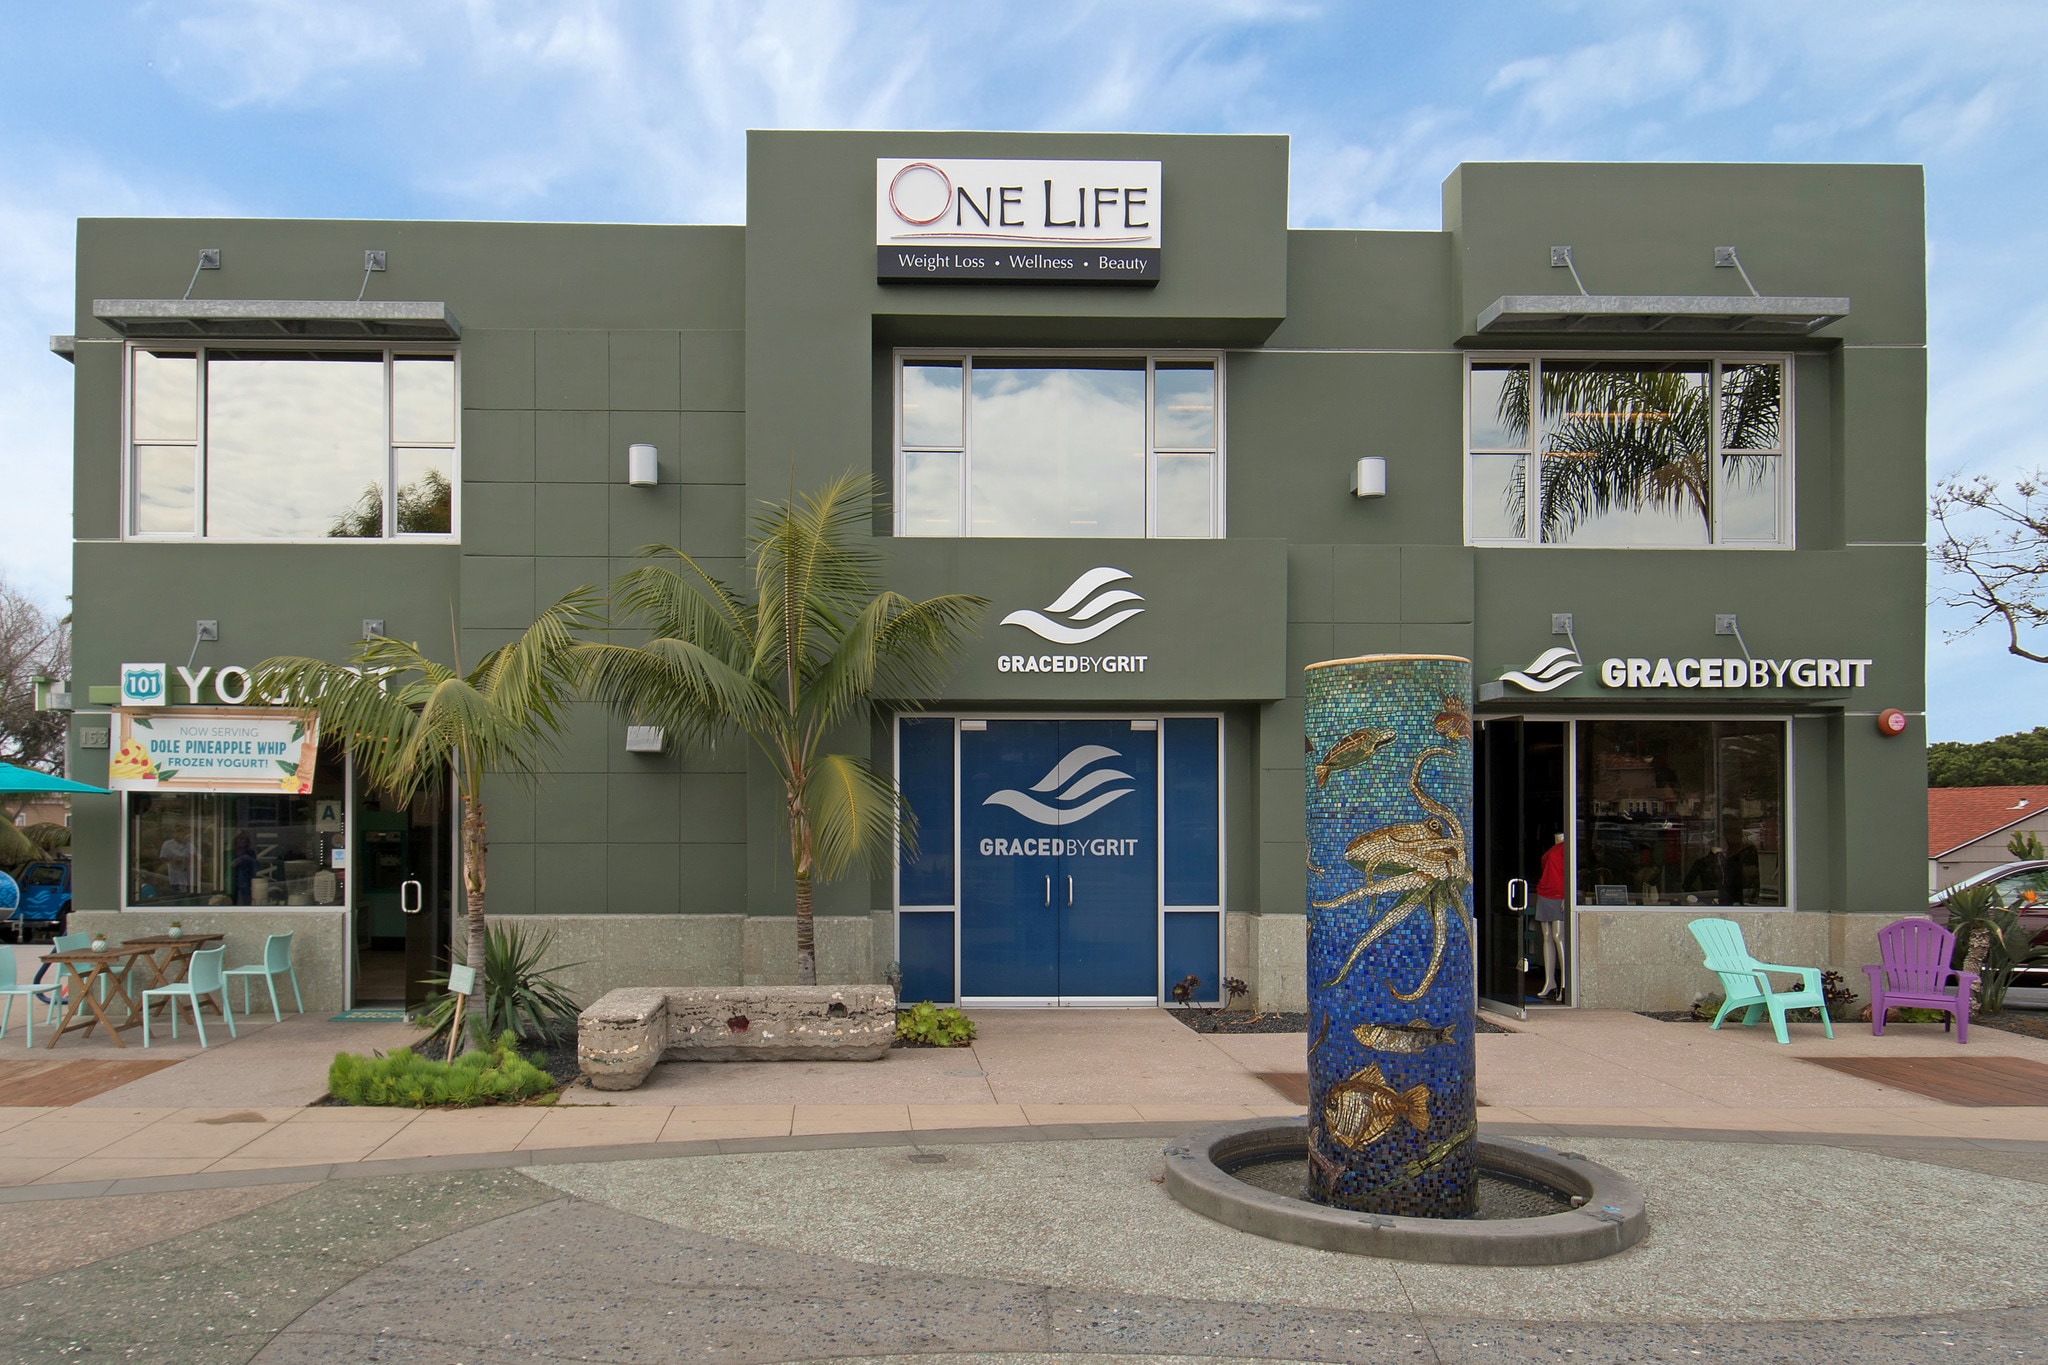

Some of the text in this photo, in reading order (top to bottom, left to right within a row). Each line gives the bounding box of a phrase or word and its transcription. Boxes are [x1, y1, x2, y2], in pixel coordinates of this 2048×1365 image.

[889, 162, 1149, 228] ONE LIFE
[898, 254, 1148, 273] Weight Loss Wellness Beauty
[997, 655, 1148, 672] GRACEDBYGRIT
[1601, 658, 1873, 688] GRACEDBYGRIT
[129, 676, 157, 693] 101
[180, 727, 259, 737] NOW SERVING
[150, 739, 287, 755] DOLE PINEAPPLE WHIP
[168, 757, 269, 768] FROZEN YOGURT!
[322, 805, 336, 820] A
[979, 838, 1138, 856] GRACEDBYGRIT
